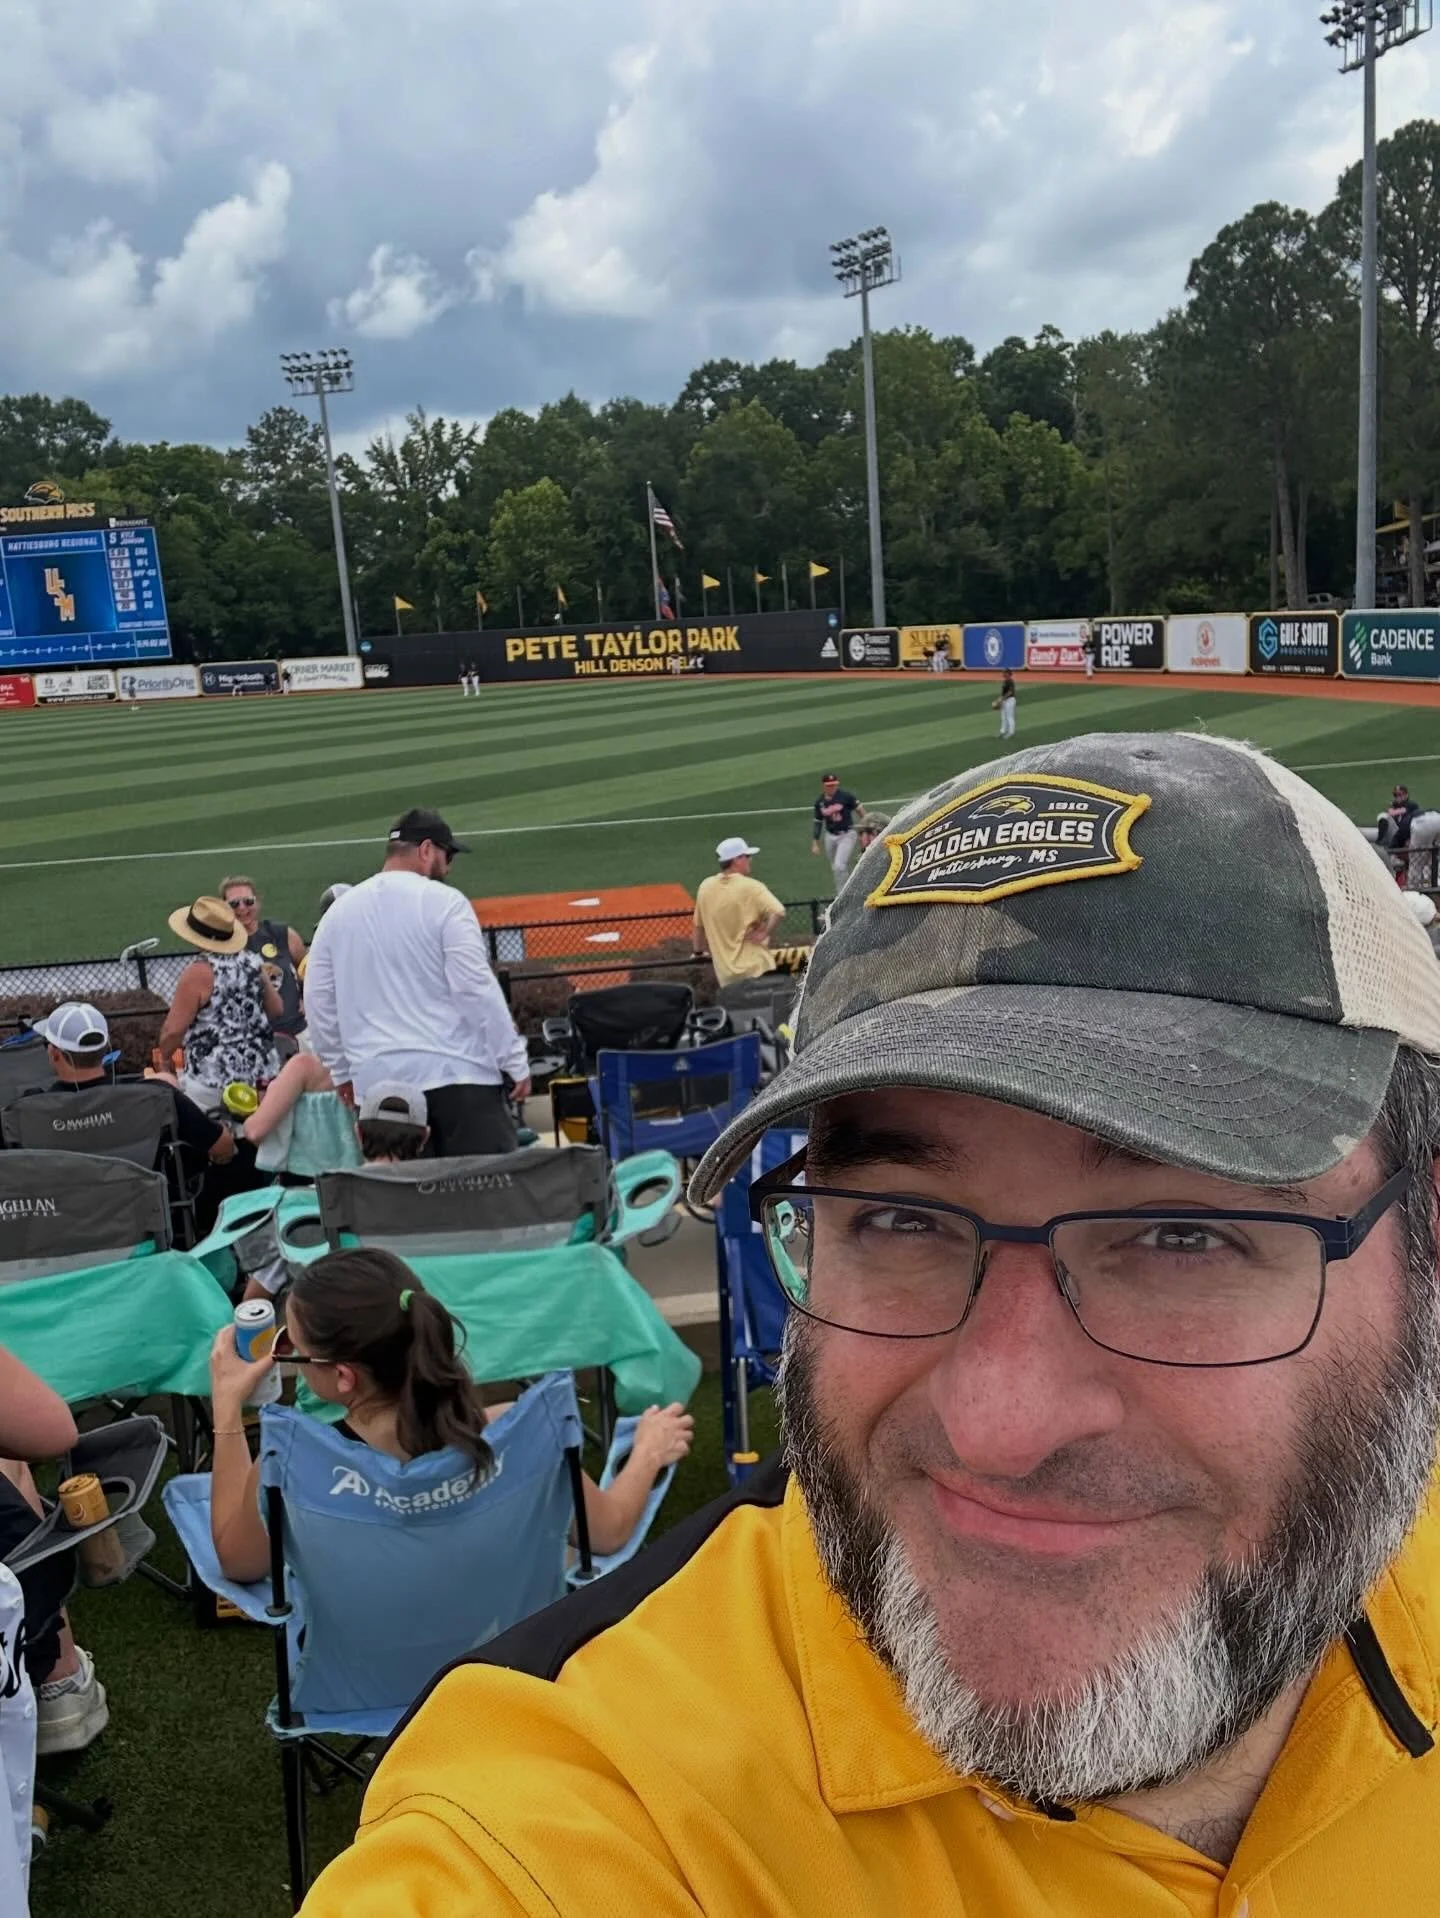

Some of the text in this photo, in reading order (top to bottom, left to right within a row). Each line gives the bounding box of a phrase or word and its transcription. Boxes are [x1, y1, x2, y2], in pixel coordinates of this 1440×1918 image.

[0, 502, 96, 523] SOUTHERN MISS
[8, 536, 98, 551] HATTIESBURG REGIONAL
[505, 625, 742, 662] PETE TAYLOR PARK
[1101, 622, 1153, 645] POWER
[1280, 622, 1329, 646] GULF SOUTH
[1370, 628, 1435, 651] CADENCE
[574, 659, 607, 675] HILL
[610, 656, 664, 673] DENSON
[1102, 645, 1134, 667] ADE
[1371, 652, 1392, 667] Bank
[319, 662, 356, 673] MARKET
[924, 802, 1089, 839] EST 1910
[909, 820, 1095, 872] GOLDEN EAGLES
[1027, 849, 1059, 863] MS
